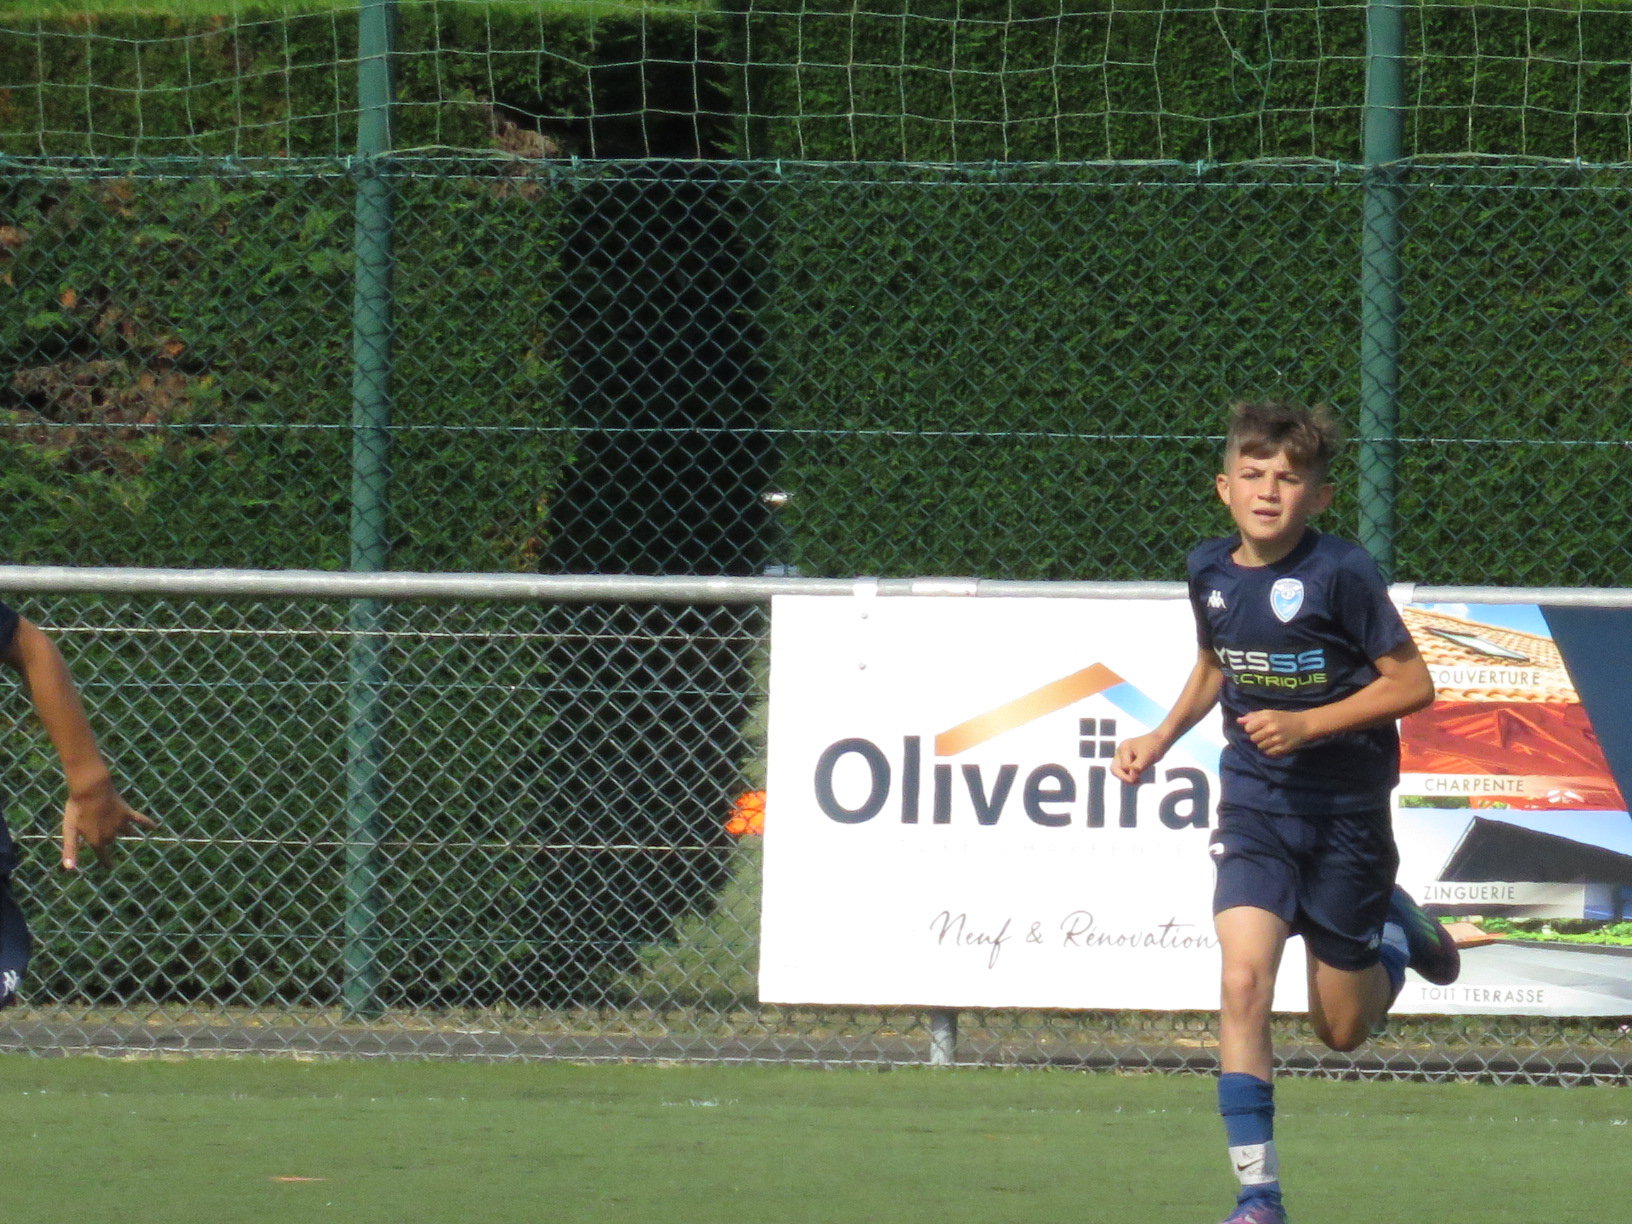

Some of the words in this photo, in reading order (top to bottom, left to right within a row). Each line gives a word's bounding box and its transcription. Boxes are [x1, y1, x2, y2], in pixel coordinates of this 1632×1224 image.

[1214, 647, 1326, 673] YESSS
[814, 735, 1210, 830] Oliveira
[1425, 778, 1524, 792] CHARPENTE
[1424, 885, 1515, 900] ZINGUERIE
[929, 910, 1012, 970] Neuf
[1025, 921, 1043, 944] &
[1421, 987, 1456, 1001] TOIT
[1464, 988, 1544, 1003] TERRASSE
